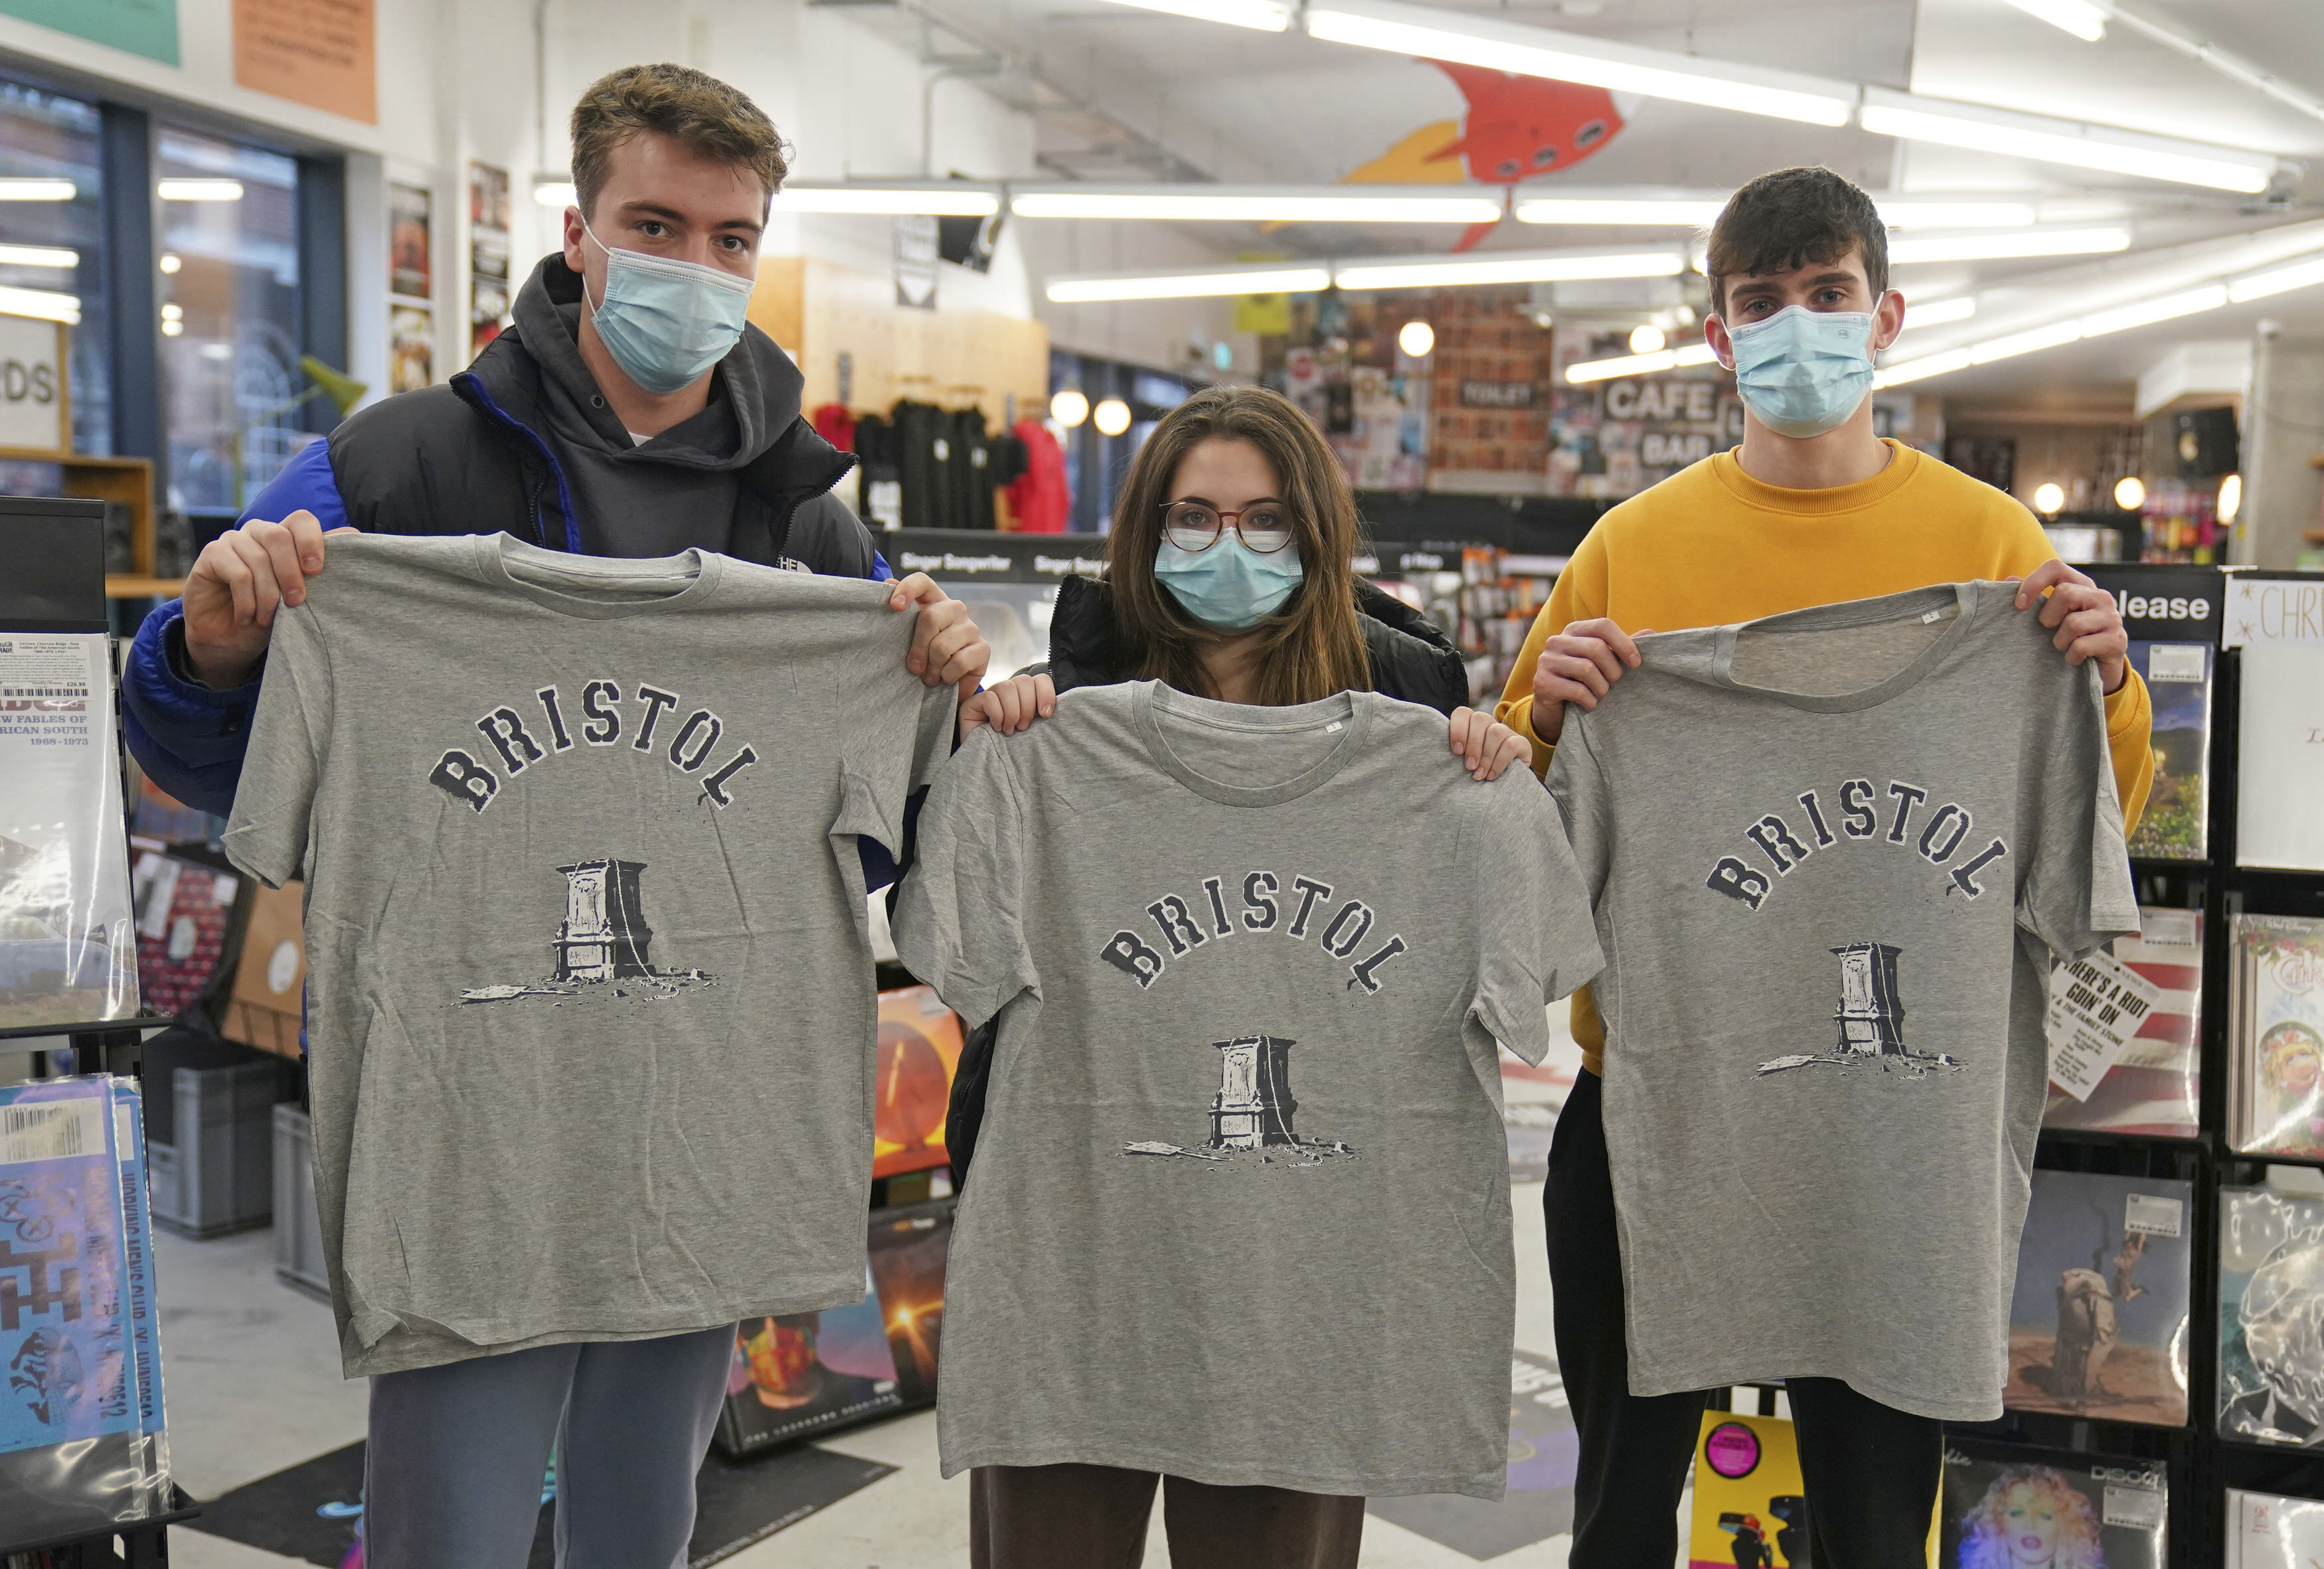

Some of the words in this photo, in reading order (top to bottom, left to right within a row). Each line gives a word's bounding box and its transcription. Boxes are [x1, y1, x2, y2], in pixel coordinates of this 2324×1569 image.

[0, 361, 53, 404] DS
[1606, 380, 1715, 420] CAFE
[1643, 434, 1711, 465] BAR
[780, 556, 797, 572] HE
[2114, 590, 2210, 620] lease
[429, 679, 760, 815] BRISTOL
[1705, 778, 2010, 912] BRISTOL
[1100, 870, 1408, 996] BRISTOL
[2066, 982, 2103, 1012] GOIN'
[2098, 1003, 2121, 1027] ON
[2107, 985, 2121, 1002] A
[2117, 991, 2151, 1020] RIOT
[2062, 1002, 2076, 1016] THE
[2076, 1010, 2102, 1032] FAMILY
[2099, 1027, 2125, 1047] STONE
